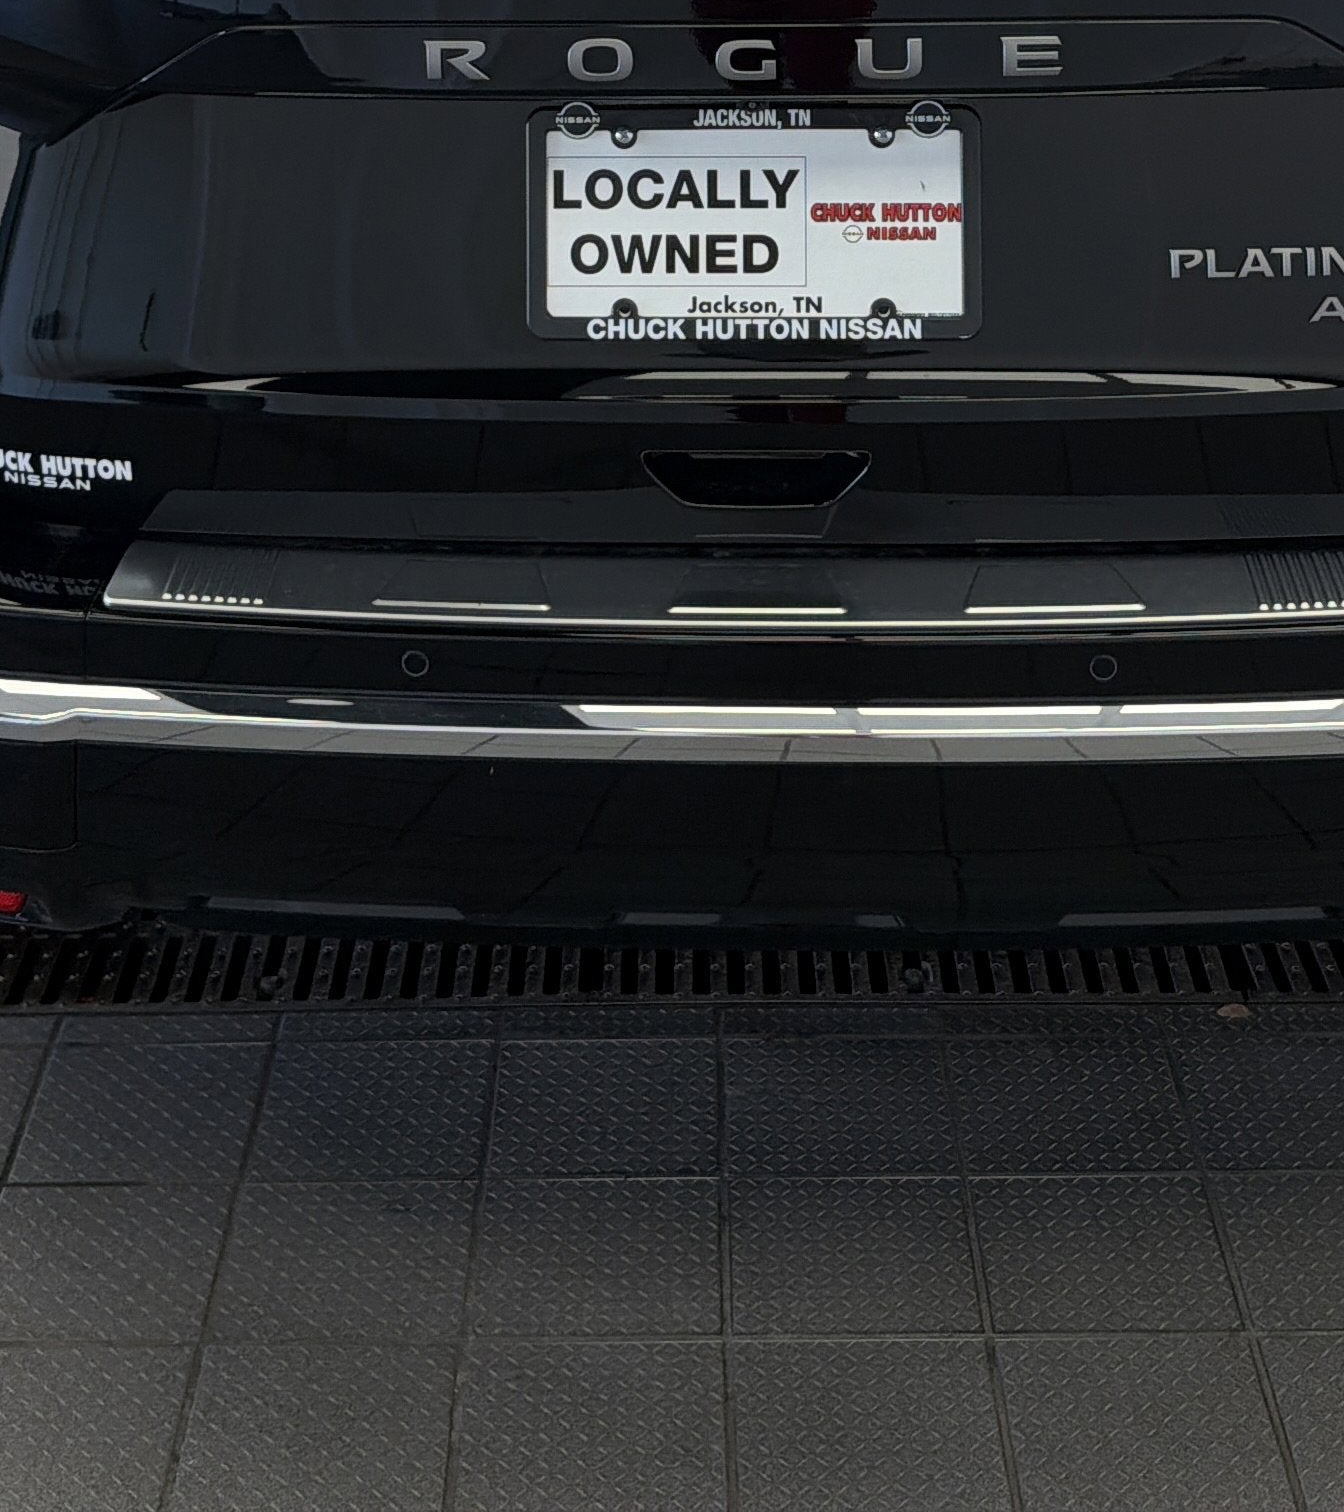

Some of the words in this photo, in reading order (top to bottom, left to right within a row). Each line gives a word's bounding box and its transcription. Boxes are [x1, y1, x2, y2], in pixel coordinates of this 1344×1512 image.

[423, 36, 1064, 82] ROGUE
[555, 116, 601, 124] NISSAN
[693, 108, 783, 129] JACKSON,
[787, 108, 811, 127] TN
[905, 115, 951, 123] NISSAN
[552, 169, 800, 209] LOCALLY
[810, 202, 876, 223] CHUCK
[881, 202, 963, 223] HUTTON
[866, 226, 937, 241] NISSAN
[570, 234, 779, 274] OWNED
[687, 295, 784, 317] Jackson,
[792, 296, 823, 314] TN
[586, 318, 687, 340] CHUCK
[695, 318, 810, 340] HUTTON
[819, 318, 922, 340] NISSAN
[39, 454, 133, 482] HUTTON
[3, 470, 92, 492] NISSAN
